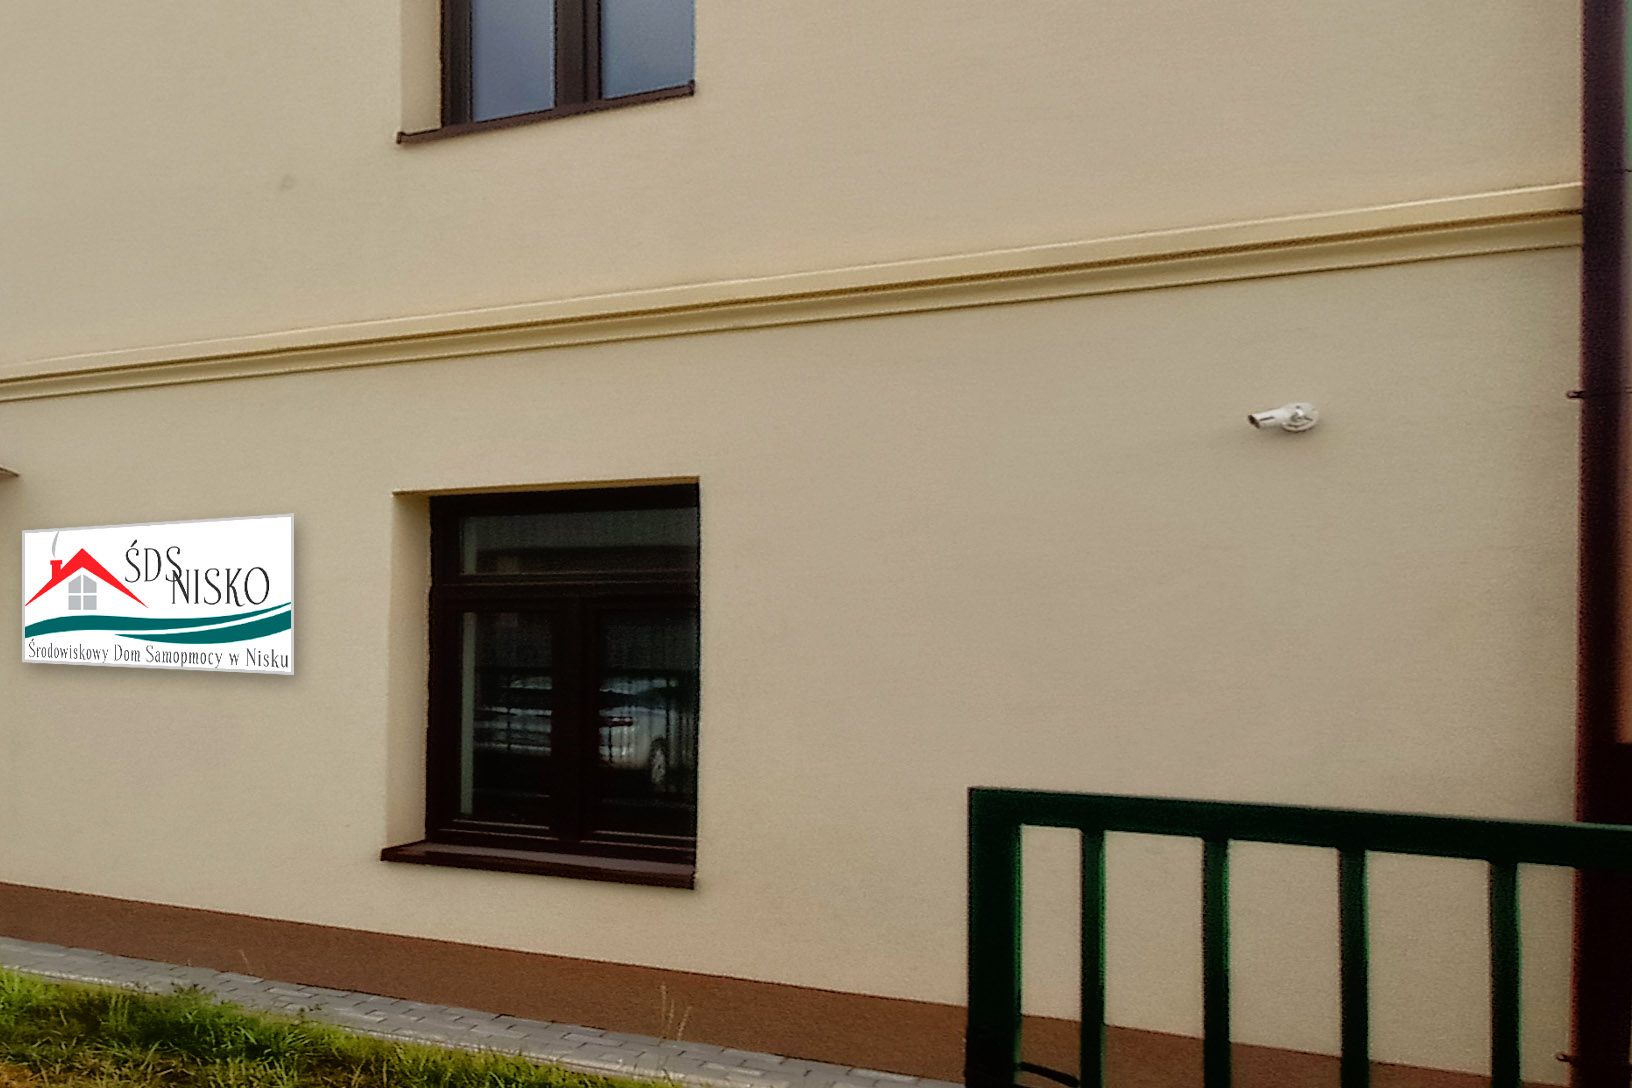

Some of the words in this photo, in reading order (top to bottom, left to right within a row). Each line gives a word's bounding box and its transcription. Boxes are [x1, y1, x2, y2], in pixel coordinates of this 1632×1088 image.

[125, 539, 182, 583] ŚDS
[172, 566, 270, 607] NISKO
[28, 638, 109, 663] Środowiskowy
[114, 644, 141, 662] Dom
[145, 644, 223, 669] Samopmocy
[228, 653, 240, 666] w
[245, 648, 289, 668] Nisku
